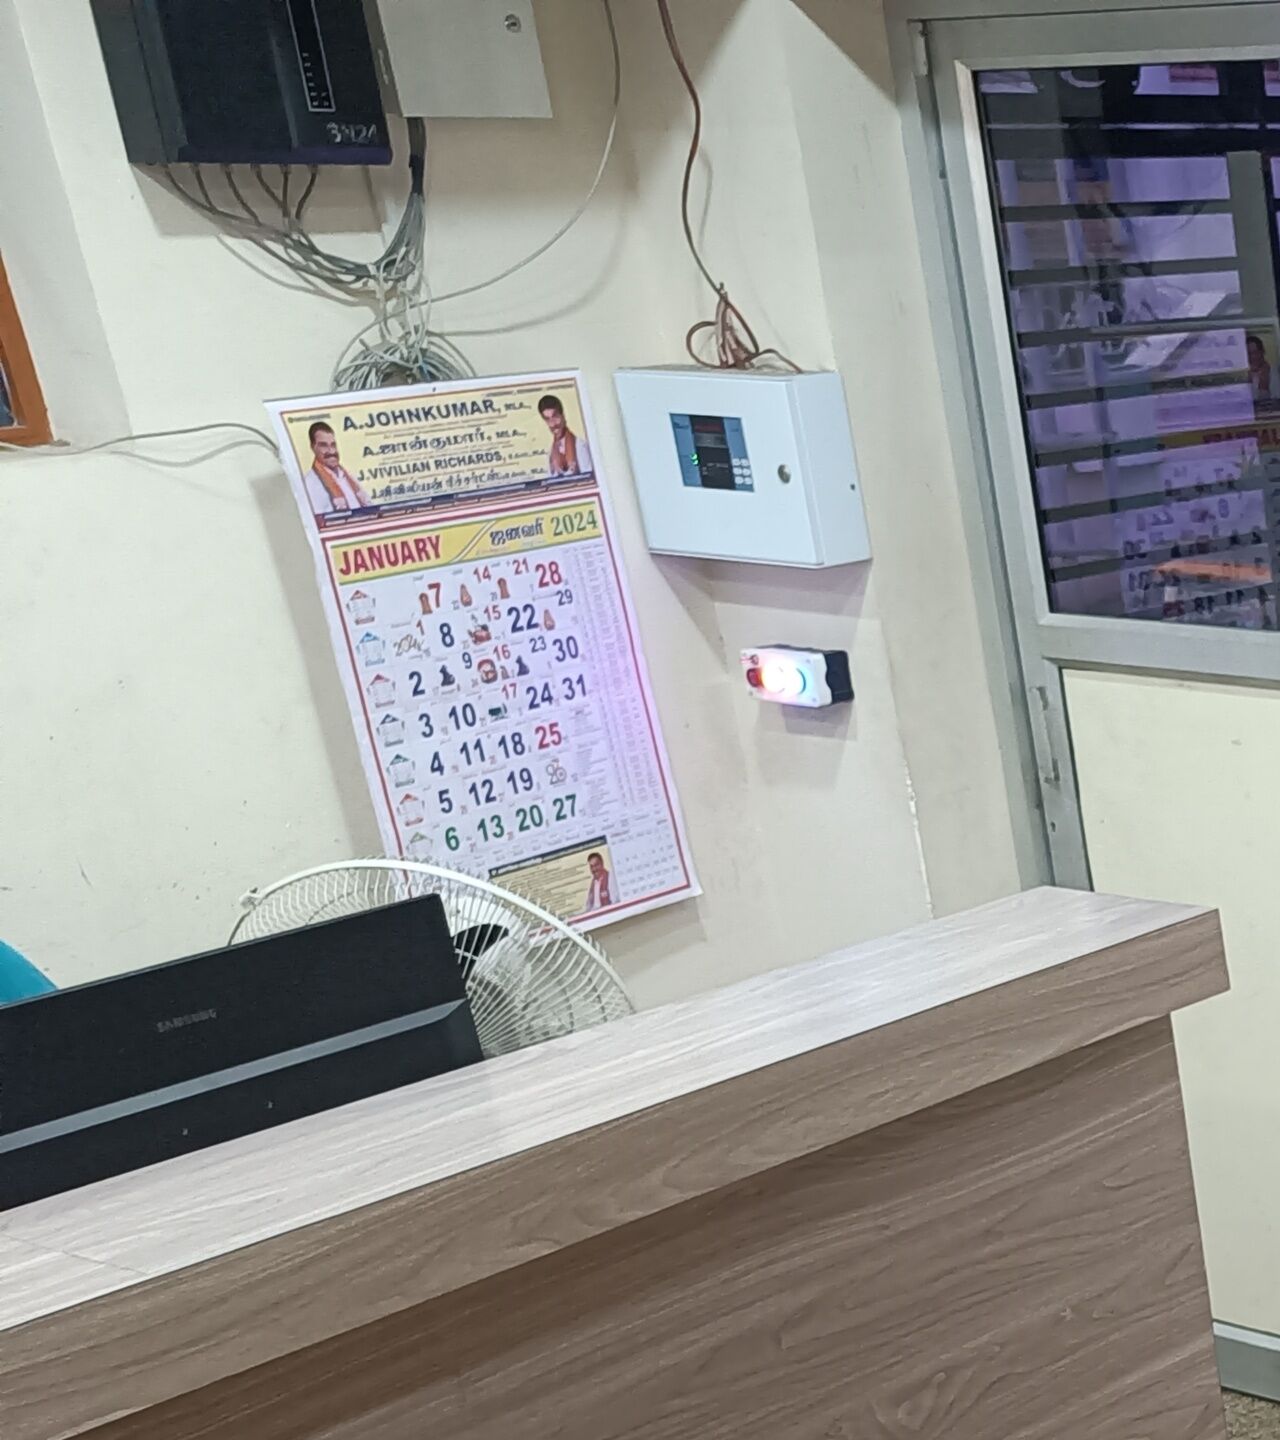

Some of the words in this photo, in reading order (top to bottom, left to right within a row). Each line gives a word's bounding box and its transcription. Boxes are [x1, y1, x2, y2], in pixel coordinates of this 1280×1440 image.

[343, 400, 501, 431] A.JOHNKUMAR,
[357, 461, 431, 481] J.VIVILIAN
[340, 535, 441, 576] JANUARY
[550, 509, 598, 536] 2024
[428, 582, 442, 608] 7
[473, 565, 492, 584] 14
[512, 558, 530, 575] 21
[535, 561, 562, 588] 28
[416, 619, 425, 636] 1
[439, 622, 455, 648] 8
[484, 604, 502, 623] 15
[507, 603, 539, 633] 22
[556, 588, 573, 606] 29
[408, 671, 426, 697] 2
[462, 651, 473, 669] 9
[493, 644, 511, 661] 16
[529, 635, 547, 653] 23
[552, 635, 579, 662] 30
[418, 713, 434, 738] 3
[448, 702, 477, 731] 10
[502, 682, 518, 700] 17
[525, 682, 554, 710] 24
[562, 673, 586, 700] 31
[430, 751, 445, 776] 4
[460, 738, 486, 766] 11
[498, 731, 526, 759] 18
[535, 722, 562, 750] 25
[438, 789, 453, 814] 5
[469, 778, 497, 806] 12
[507, 767, 534, 795] 19
[445, 826, 460, 851] 6
[477, 814, 505, 842] 13
[516, 804, 543, 832] 20
[552, 793, 577, 821] 27
[157, 1009, 217, 1032] SAMSUNG
